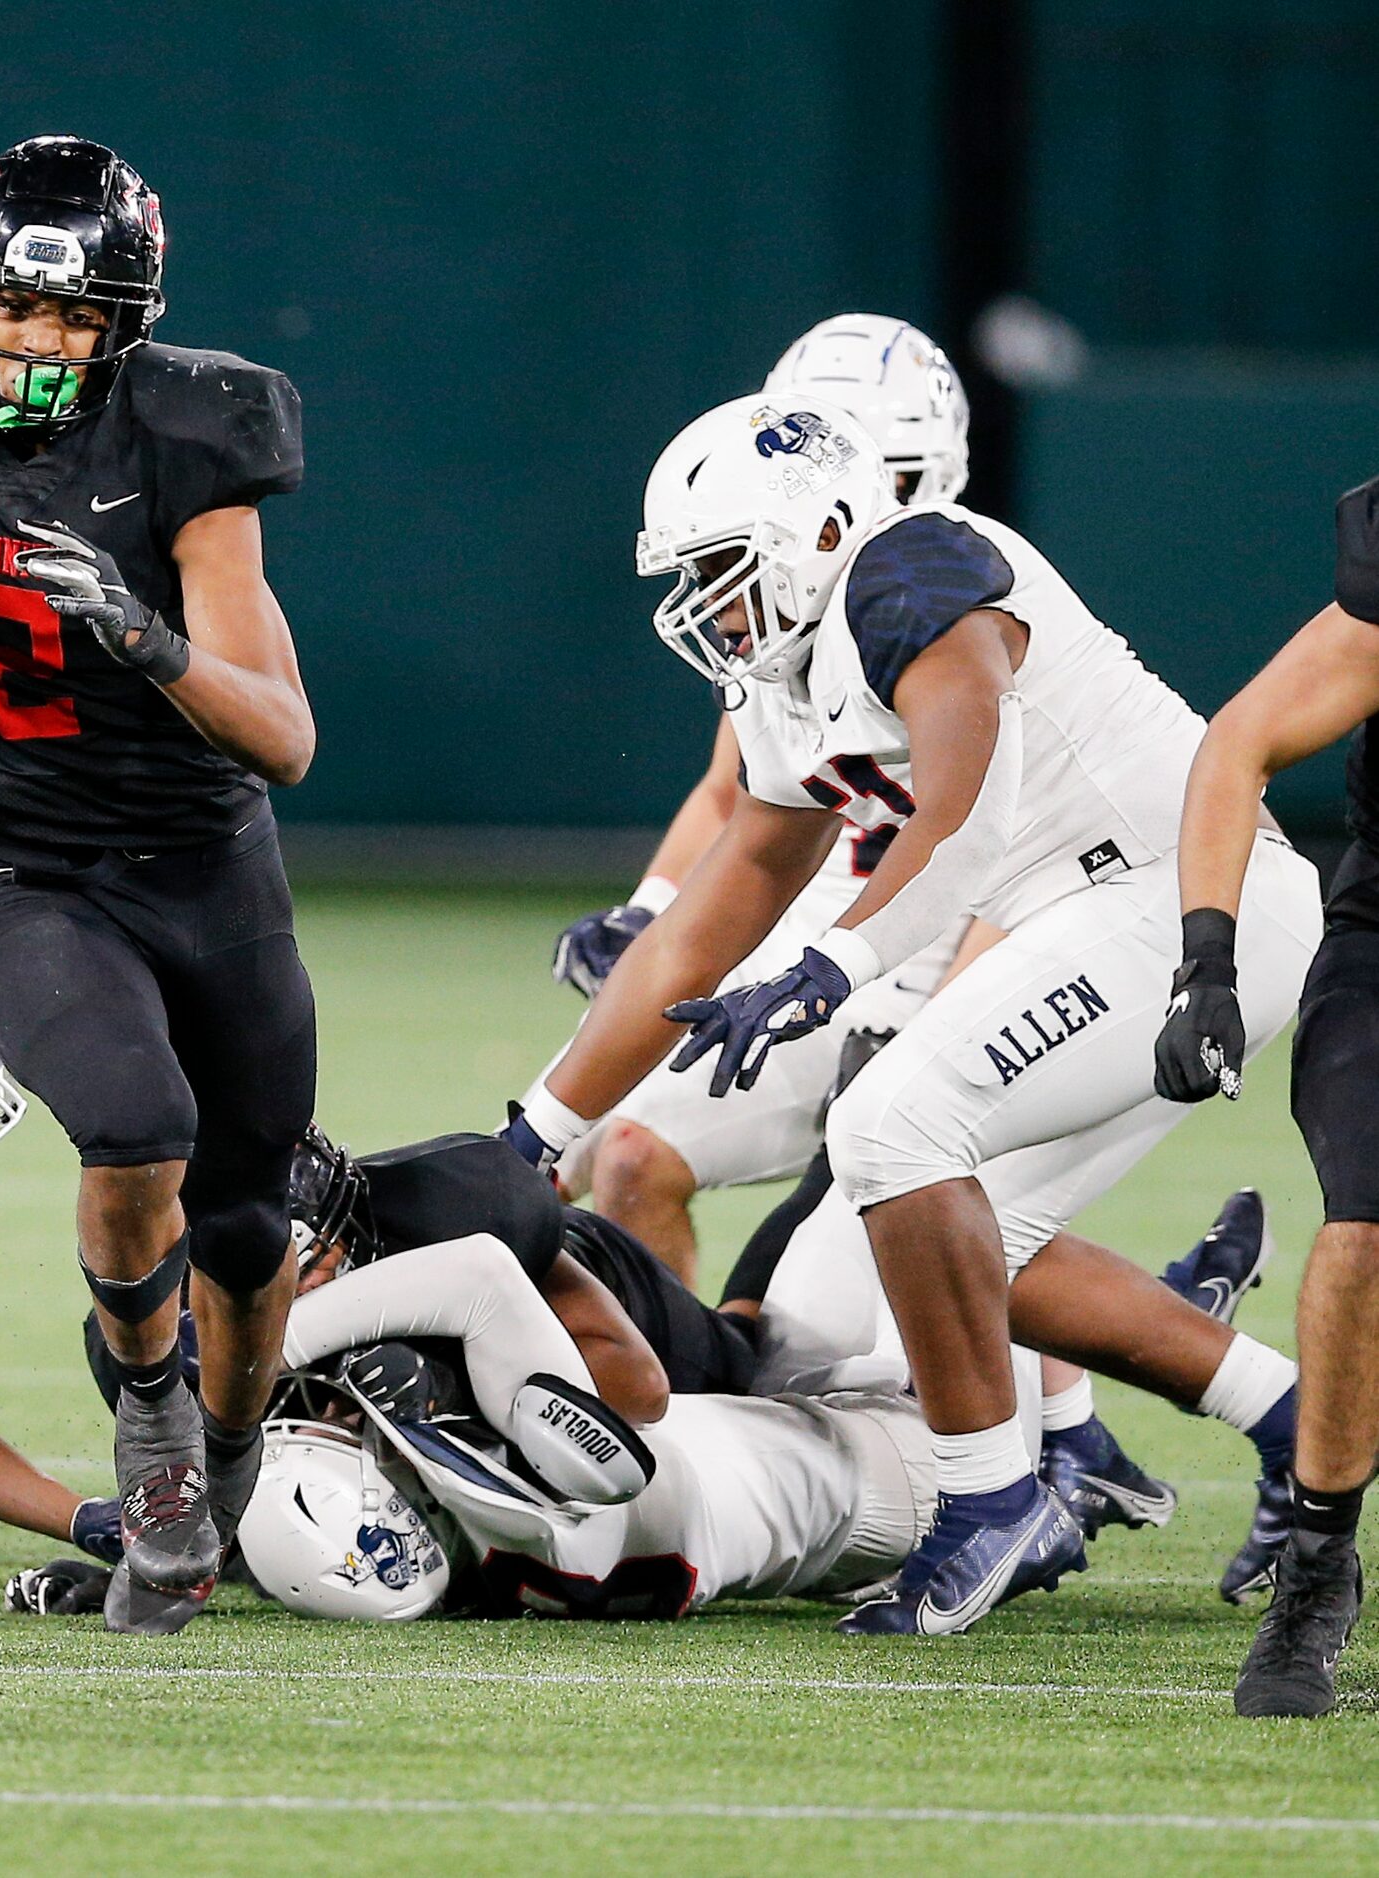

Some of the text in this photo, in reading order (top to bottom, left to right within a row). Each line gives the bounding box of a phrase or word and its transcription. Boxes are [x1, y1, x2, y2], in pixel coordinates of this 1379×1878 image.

[1087, 850, 1112, 867] XL
[983, 974, 1110, 1087] ALLEN
[538, 1398, 621, 1464] DOUGLAS
